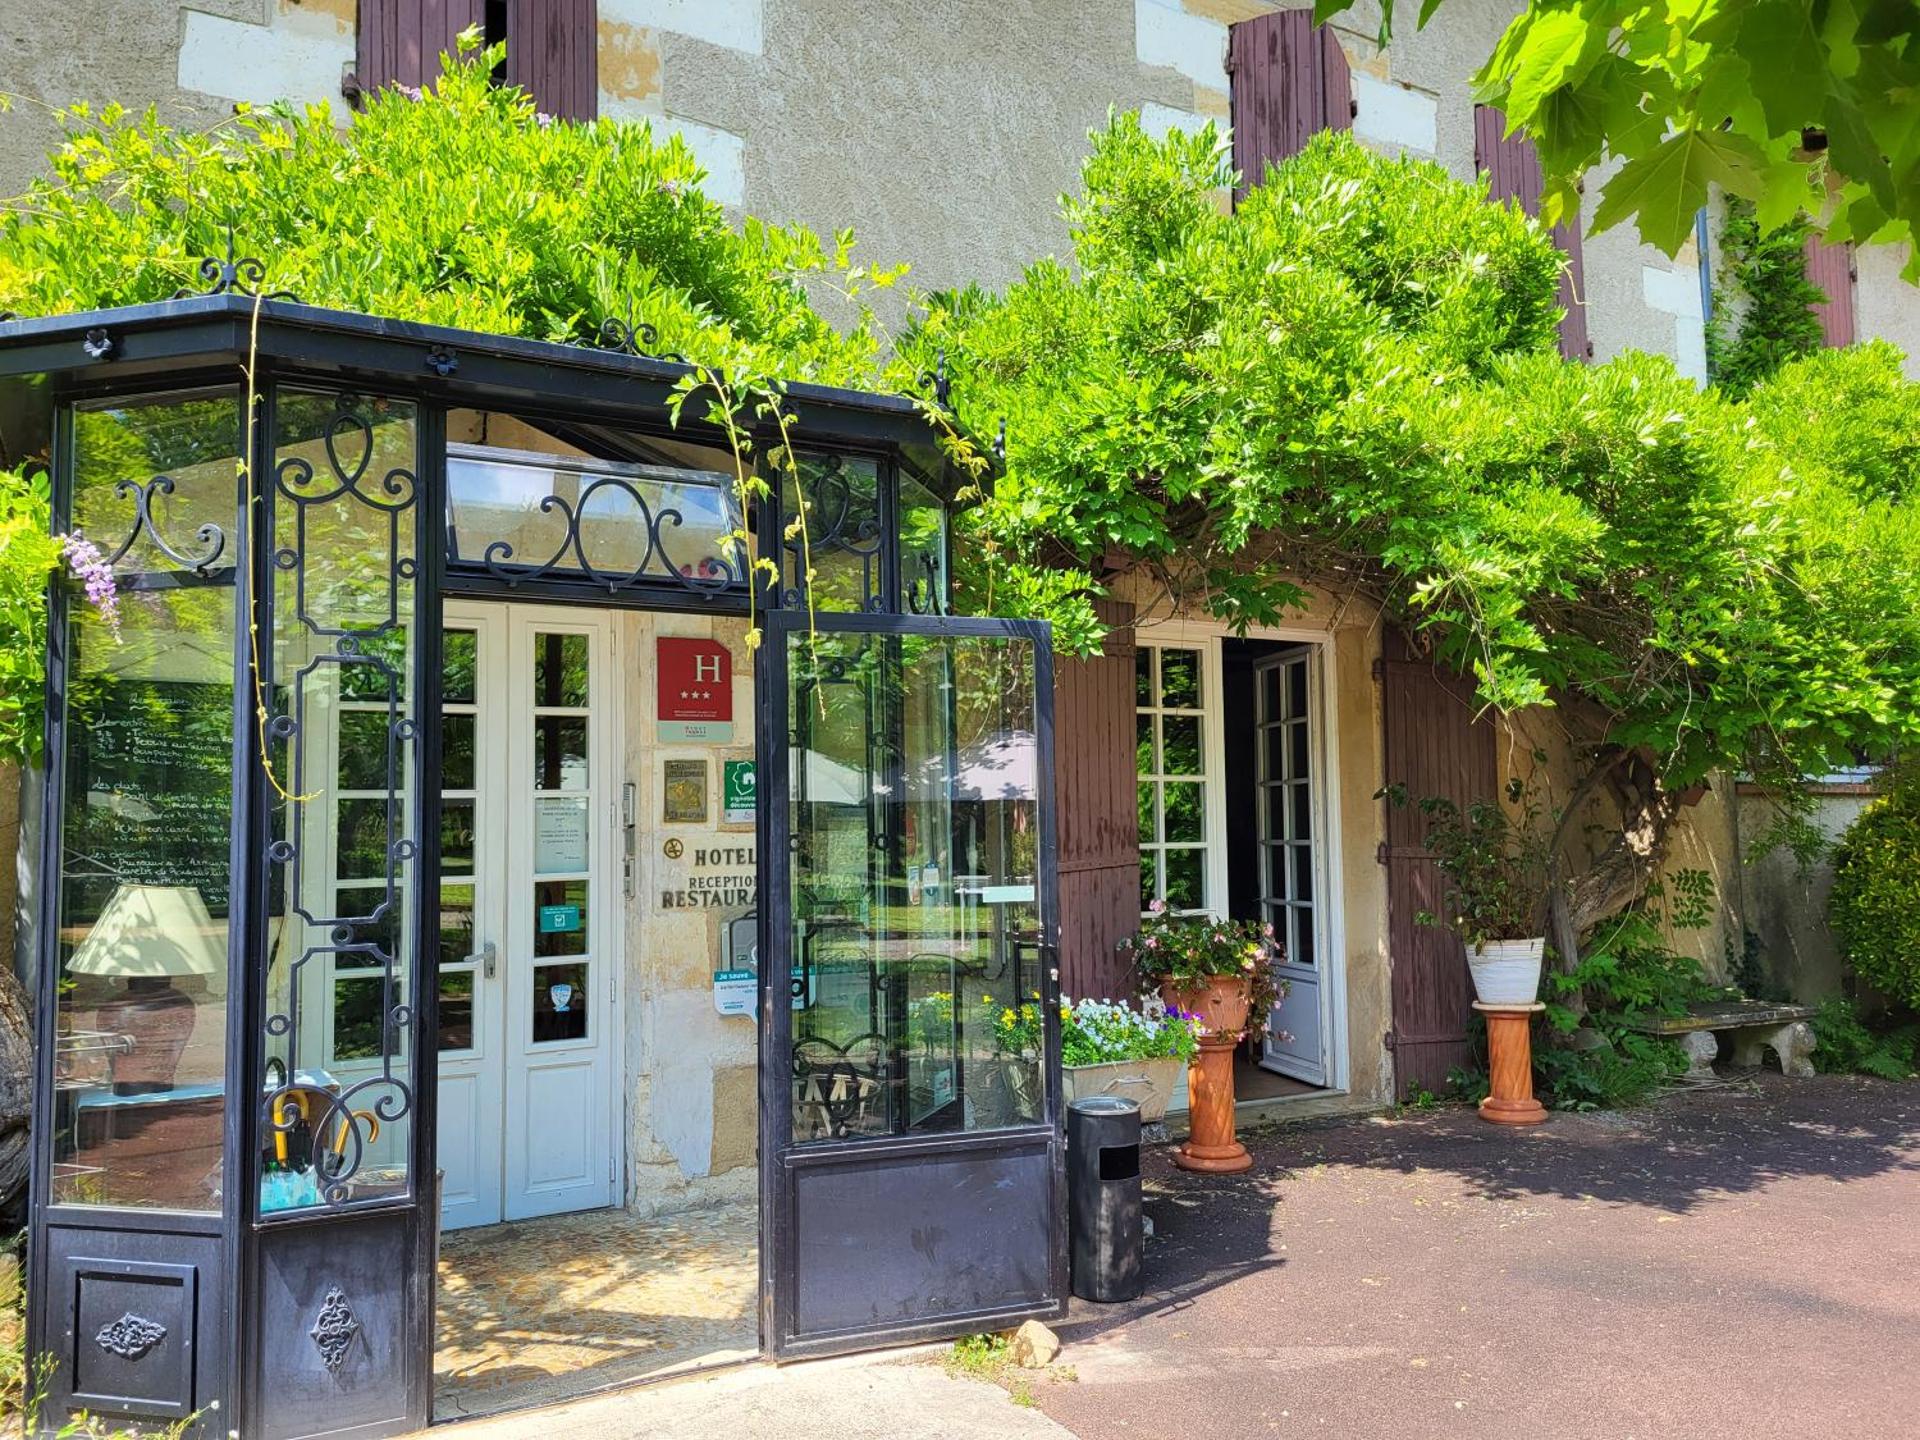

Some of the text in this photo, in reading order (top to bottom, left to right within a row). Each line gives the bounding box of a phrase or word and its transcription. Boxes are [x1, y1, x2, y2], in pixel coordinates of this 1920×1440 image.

[696, 655, 722, 683] H
[695, 848, 757, 866] HOTEL
[689, 875, 757, 889] RECEPTIO
